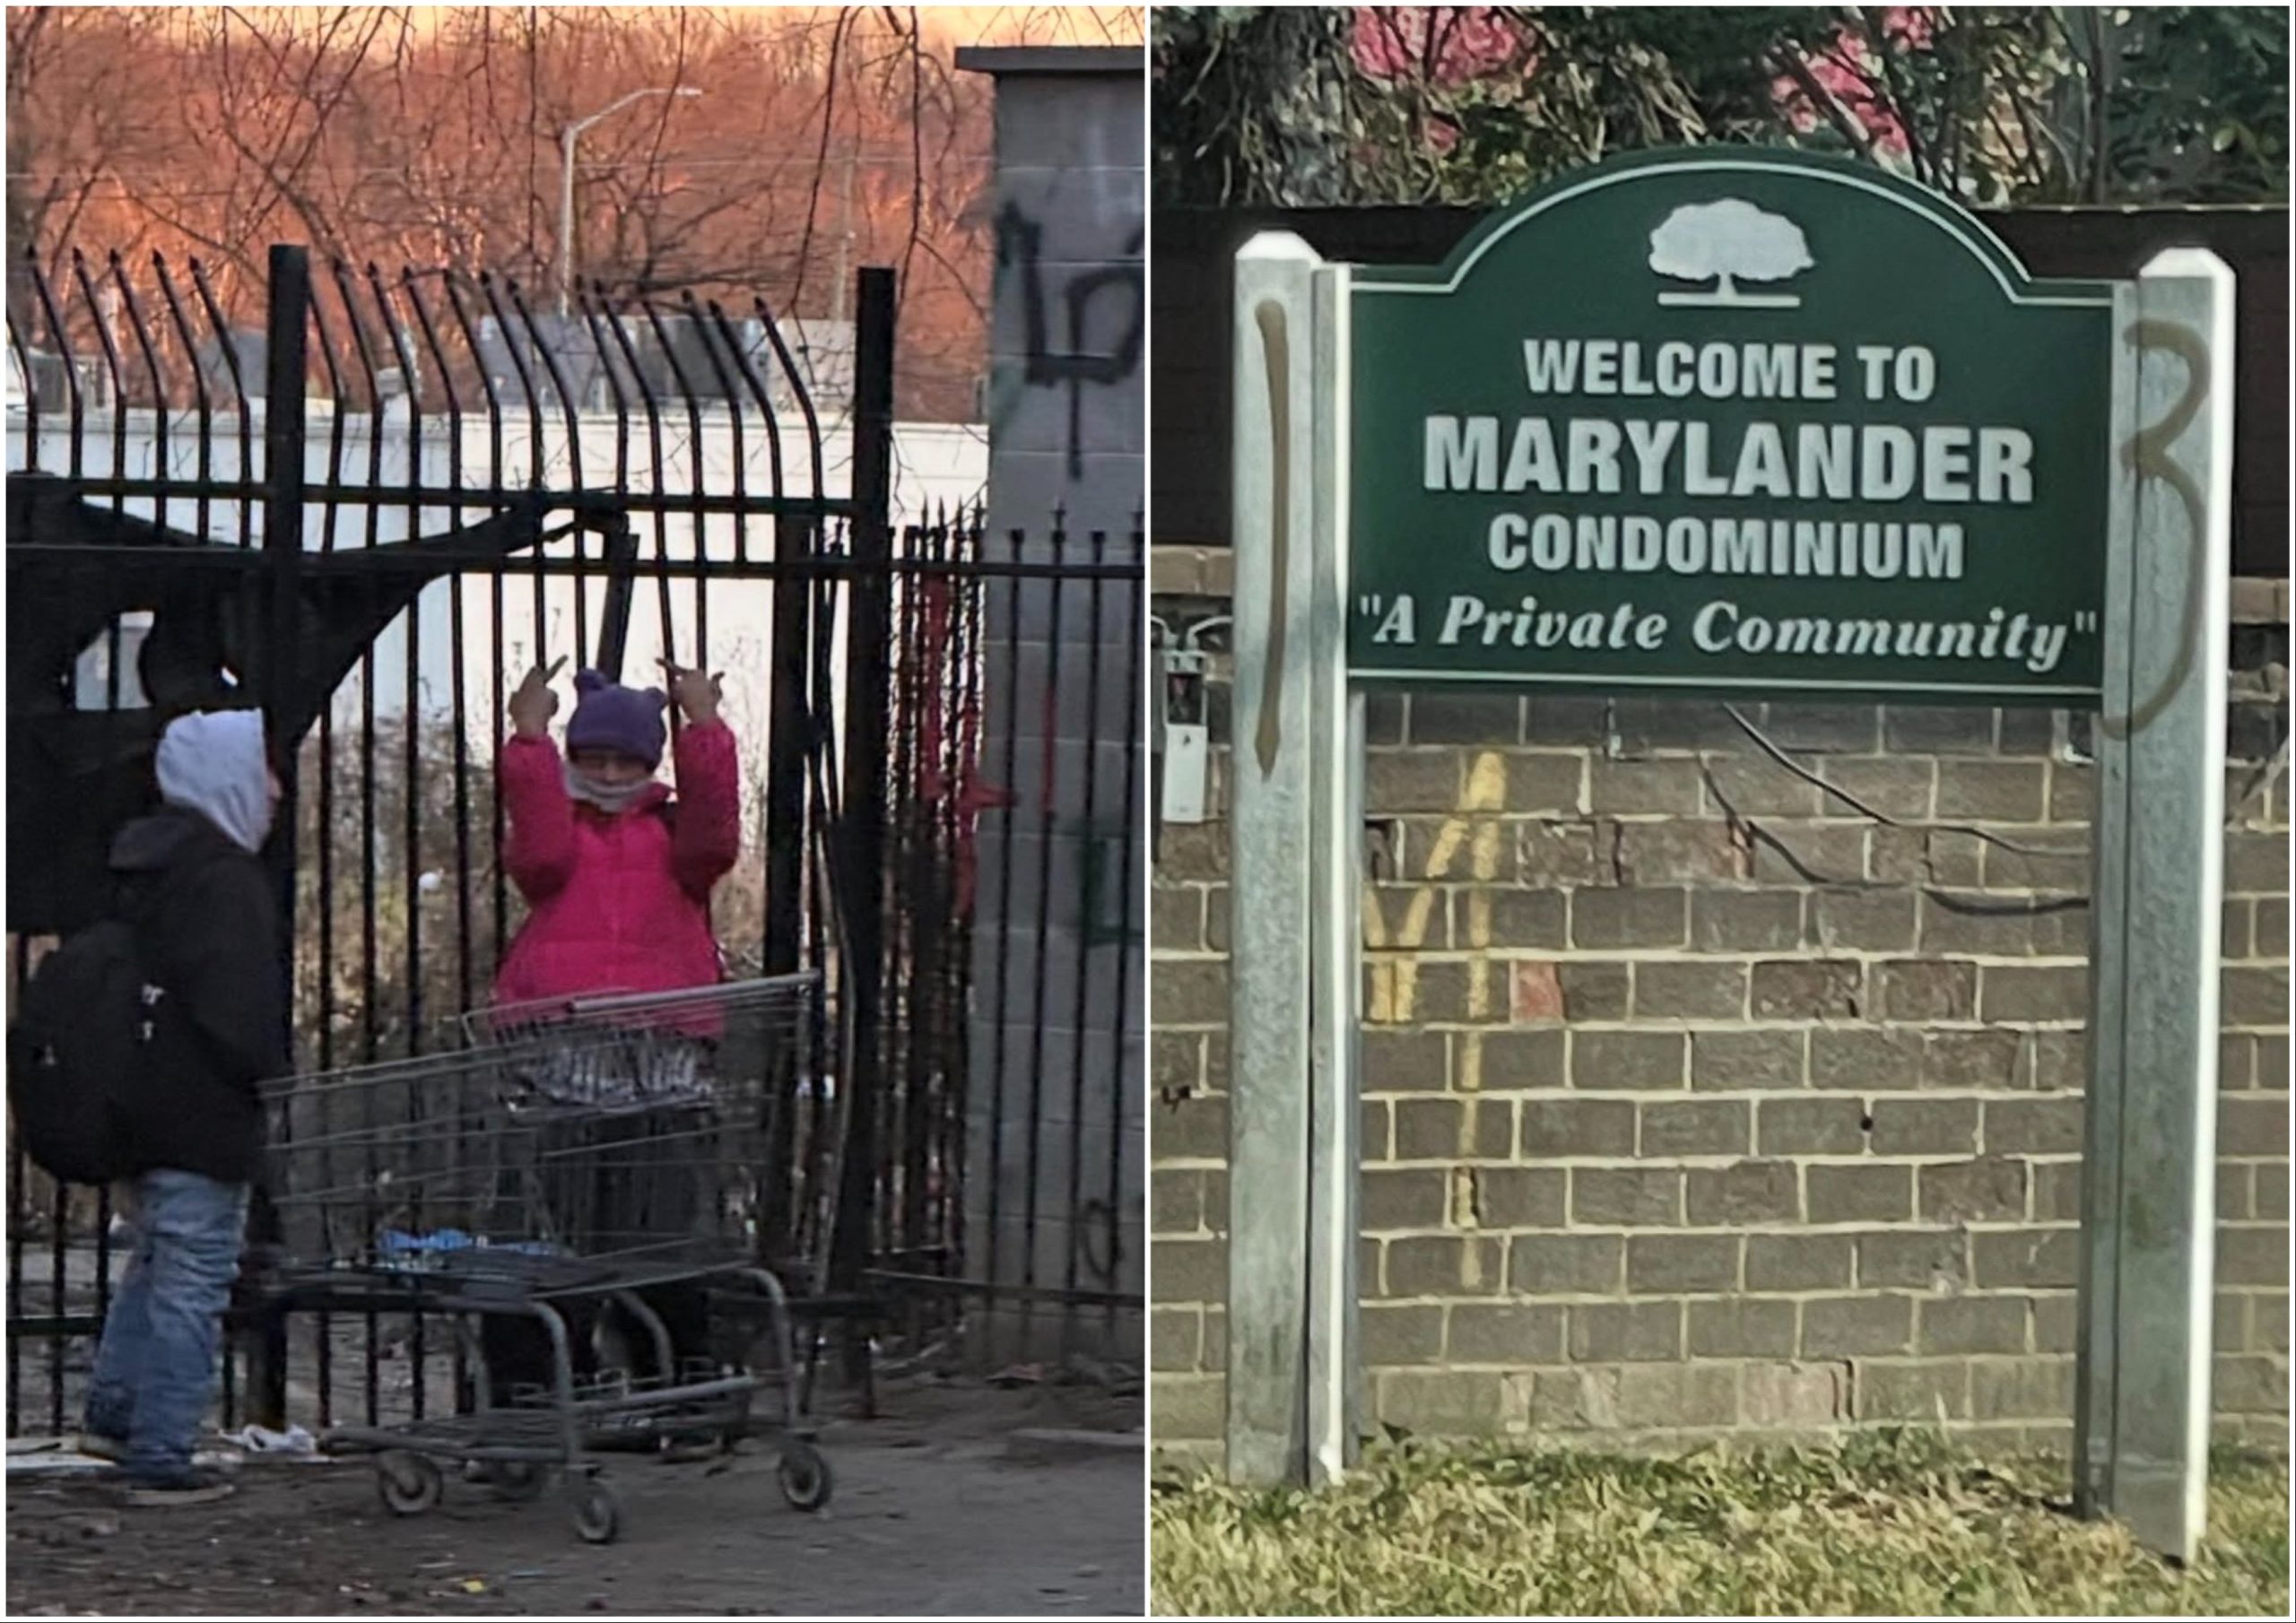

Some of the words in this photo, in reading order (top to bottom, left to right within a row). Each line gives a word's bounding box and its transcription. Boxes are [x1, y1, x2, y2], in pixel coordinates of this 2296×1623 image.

[1523, 339, 1837, 400] WELCOME
[1857, 344, 1936, 403] TO
[1423, 415, 2034, 502] MARYLANDER
[1488, 514, 1964, 579] CONDOMINIUM
[1360, 594, 1415, 644] "A
[1439, 595, 1668, 652] Private
[1692, 601, 2099, 673] Community"
